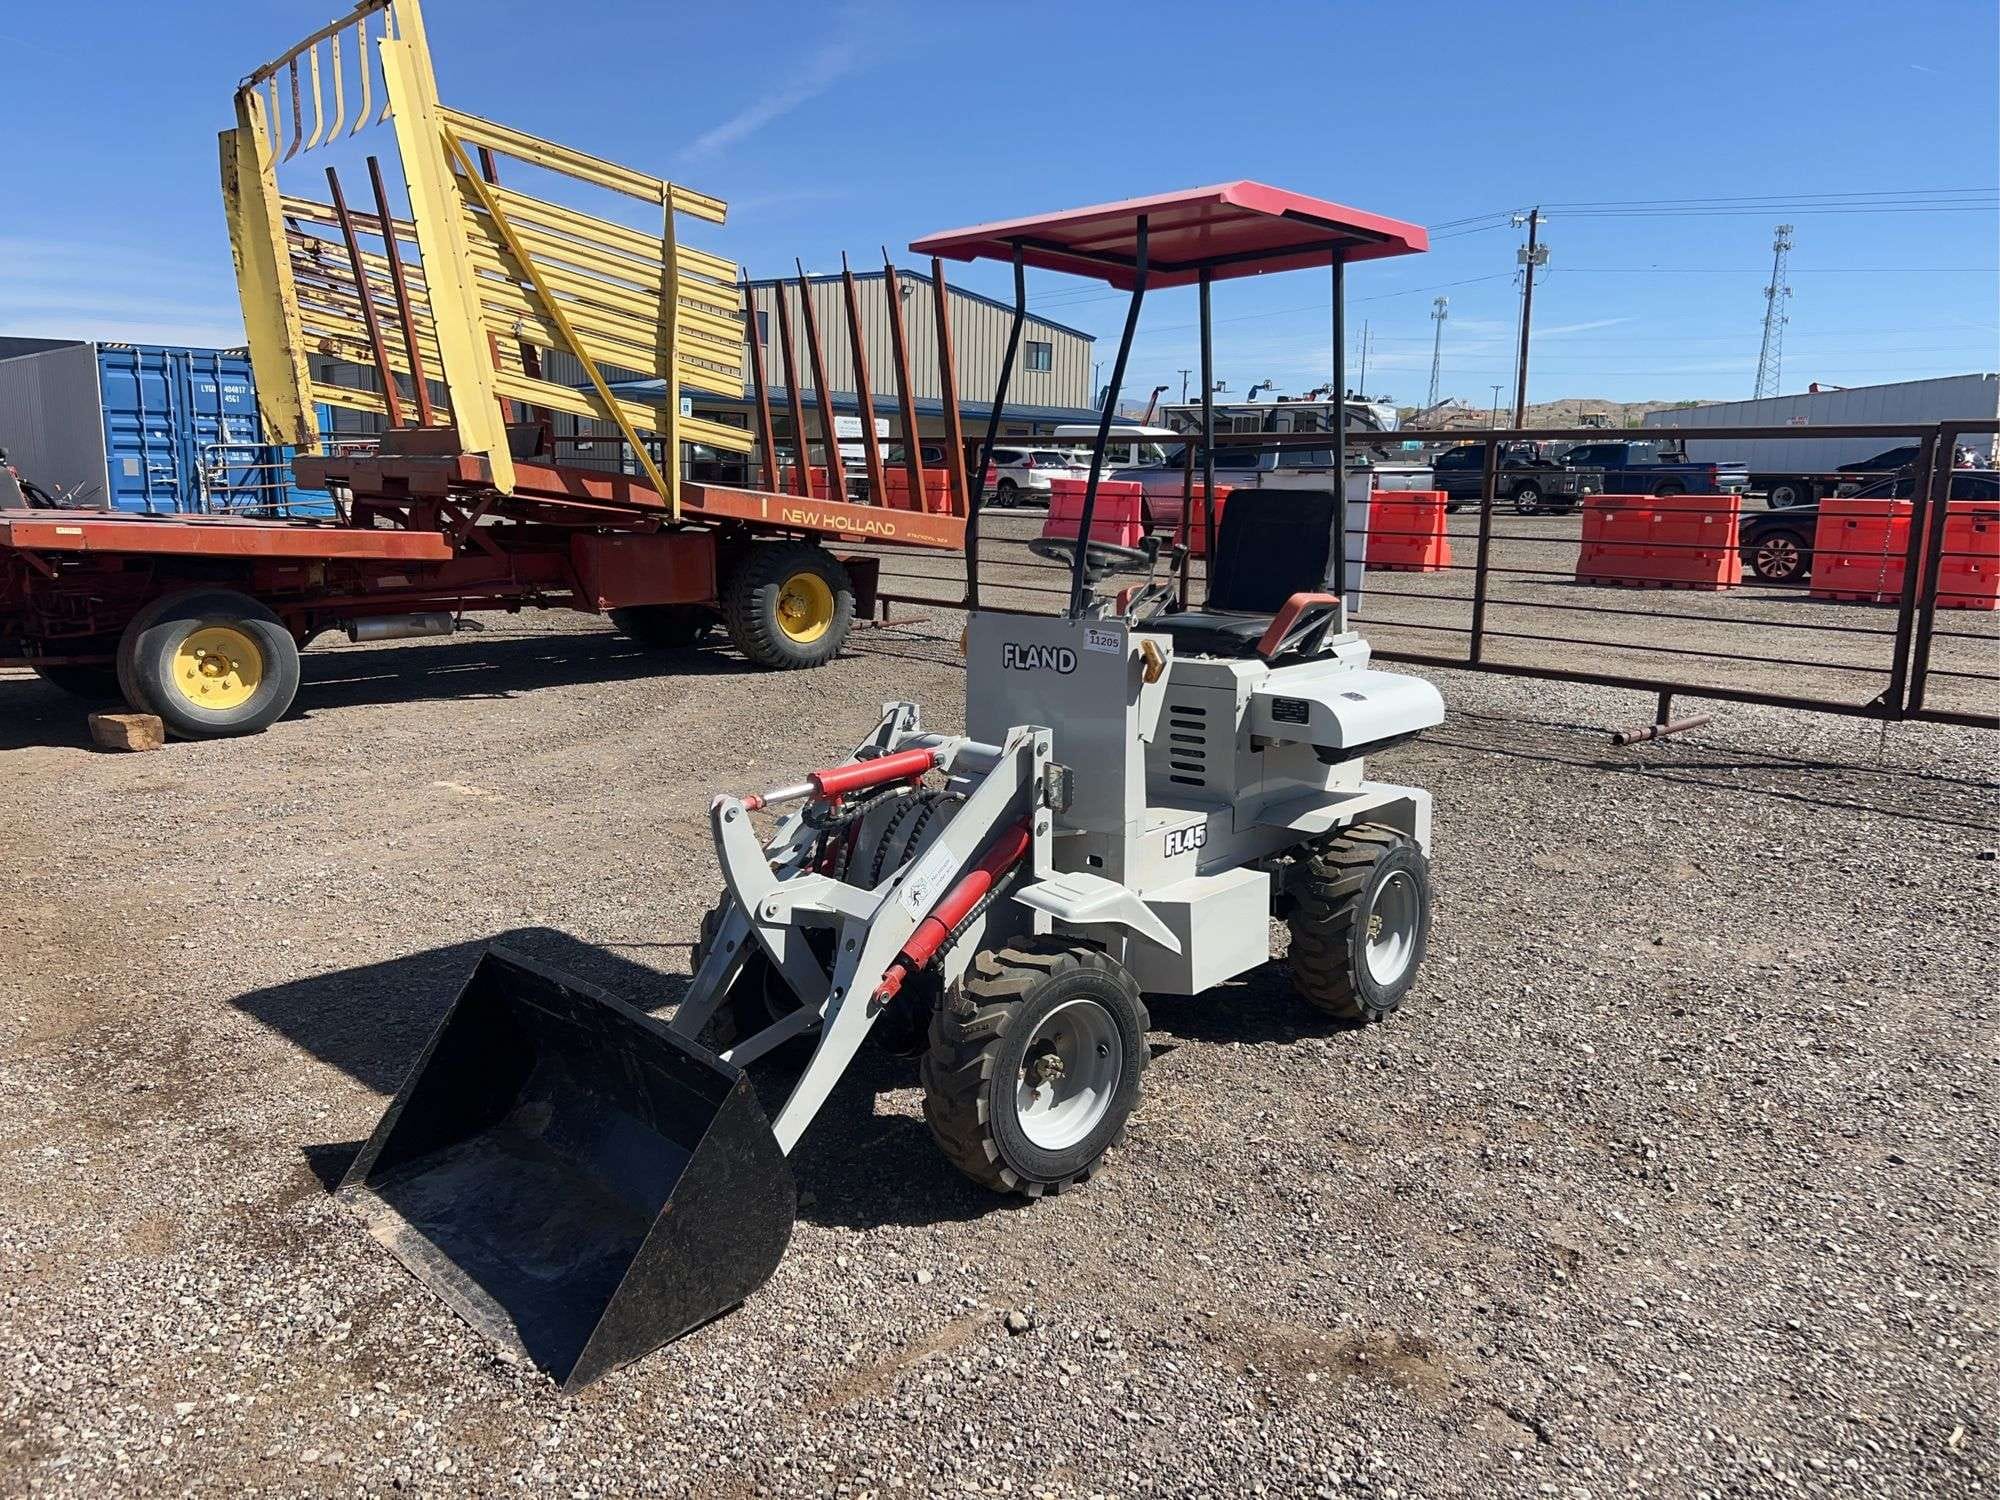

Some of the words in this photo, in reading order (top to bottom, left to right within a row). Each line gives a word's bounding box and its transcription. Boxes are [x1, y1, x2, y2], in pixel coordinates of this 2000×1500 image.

[782, 508, 820, 526] NEW
[822, 514, 896, 536] HOLLAND
[1090, 635, 1120, 648] 11205
[1003, 643, 1077, 674] FLAND
[1164, 822, 1208, 858] FL45
